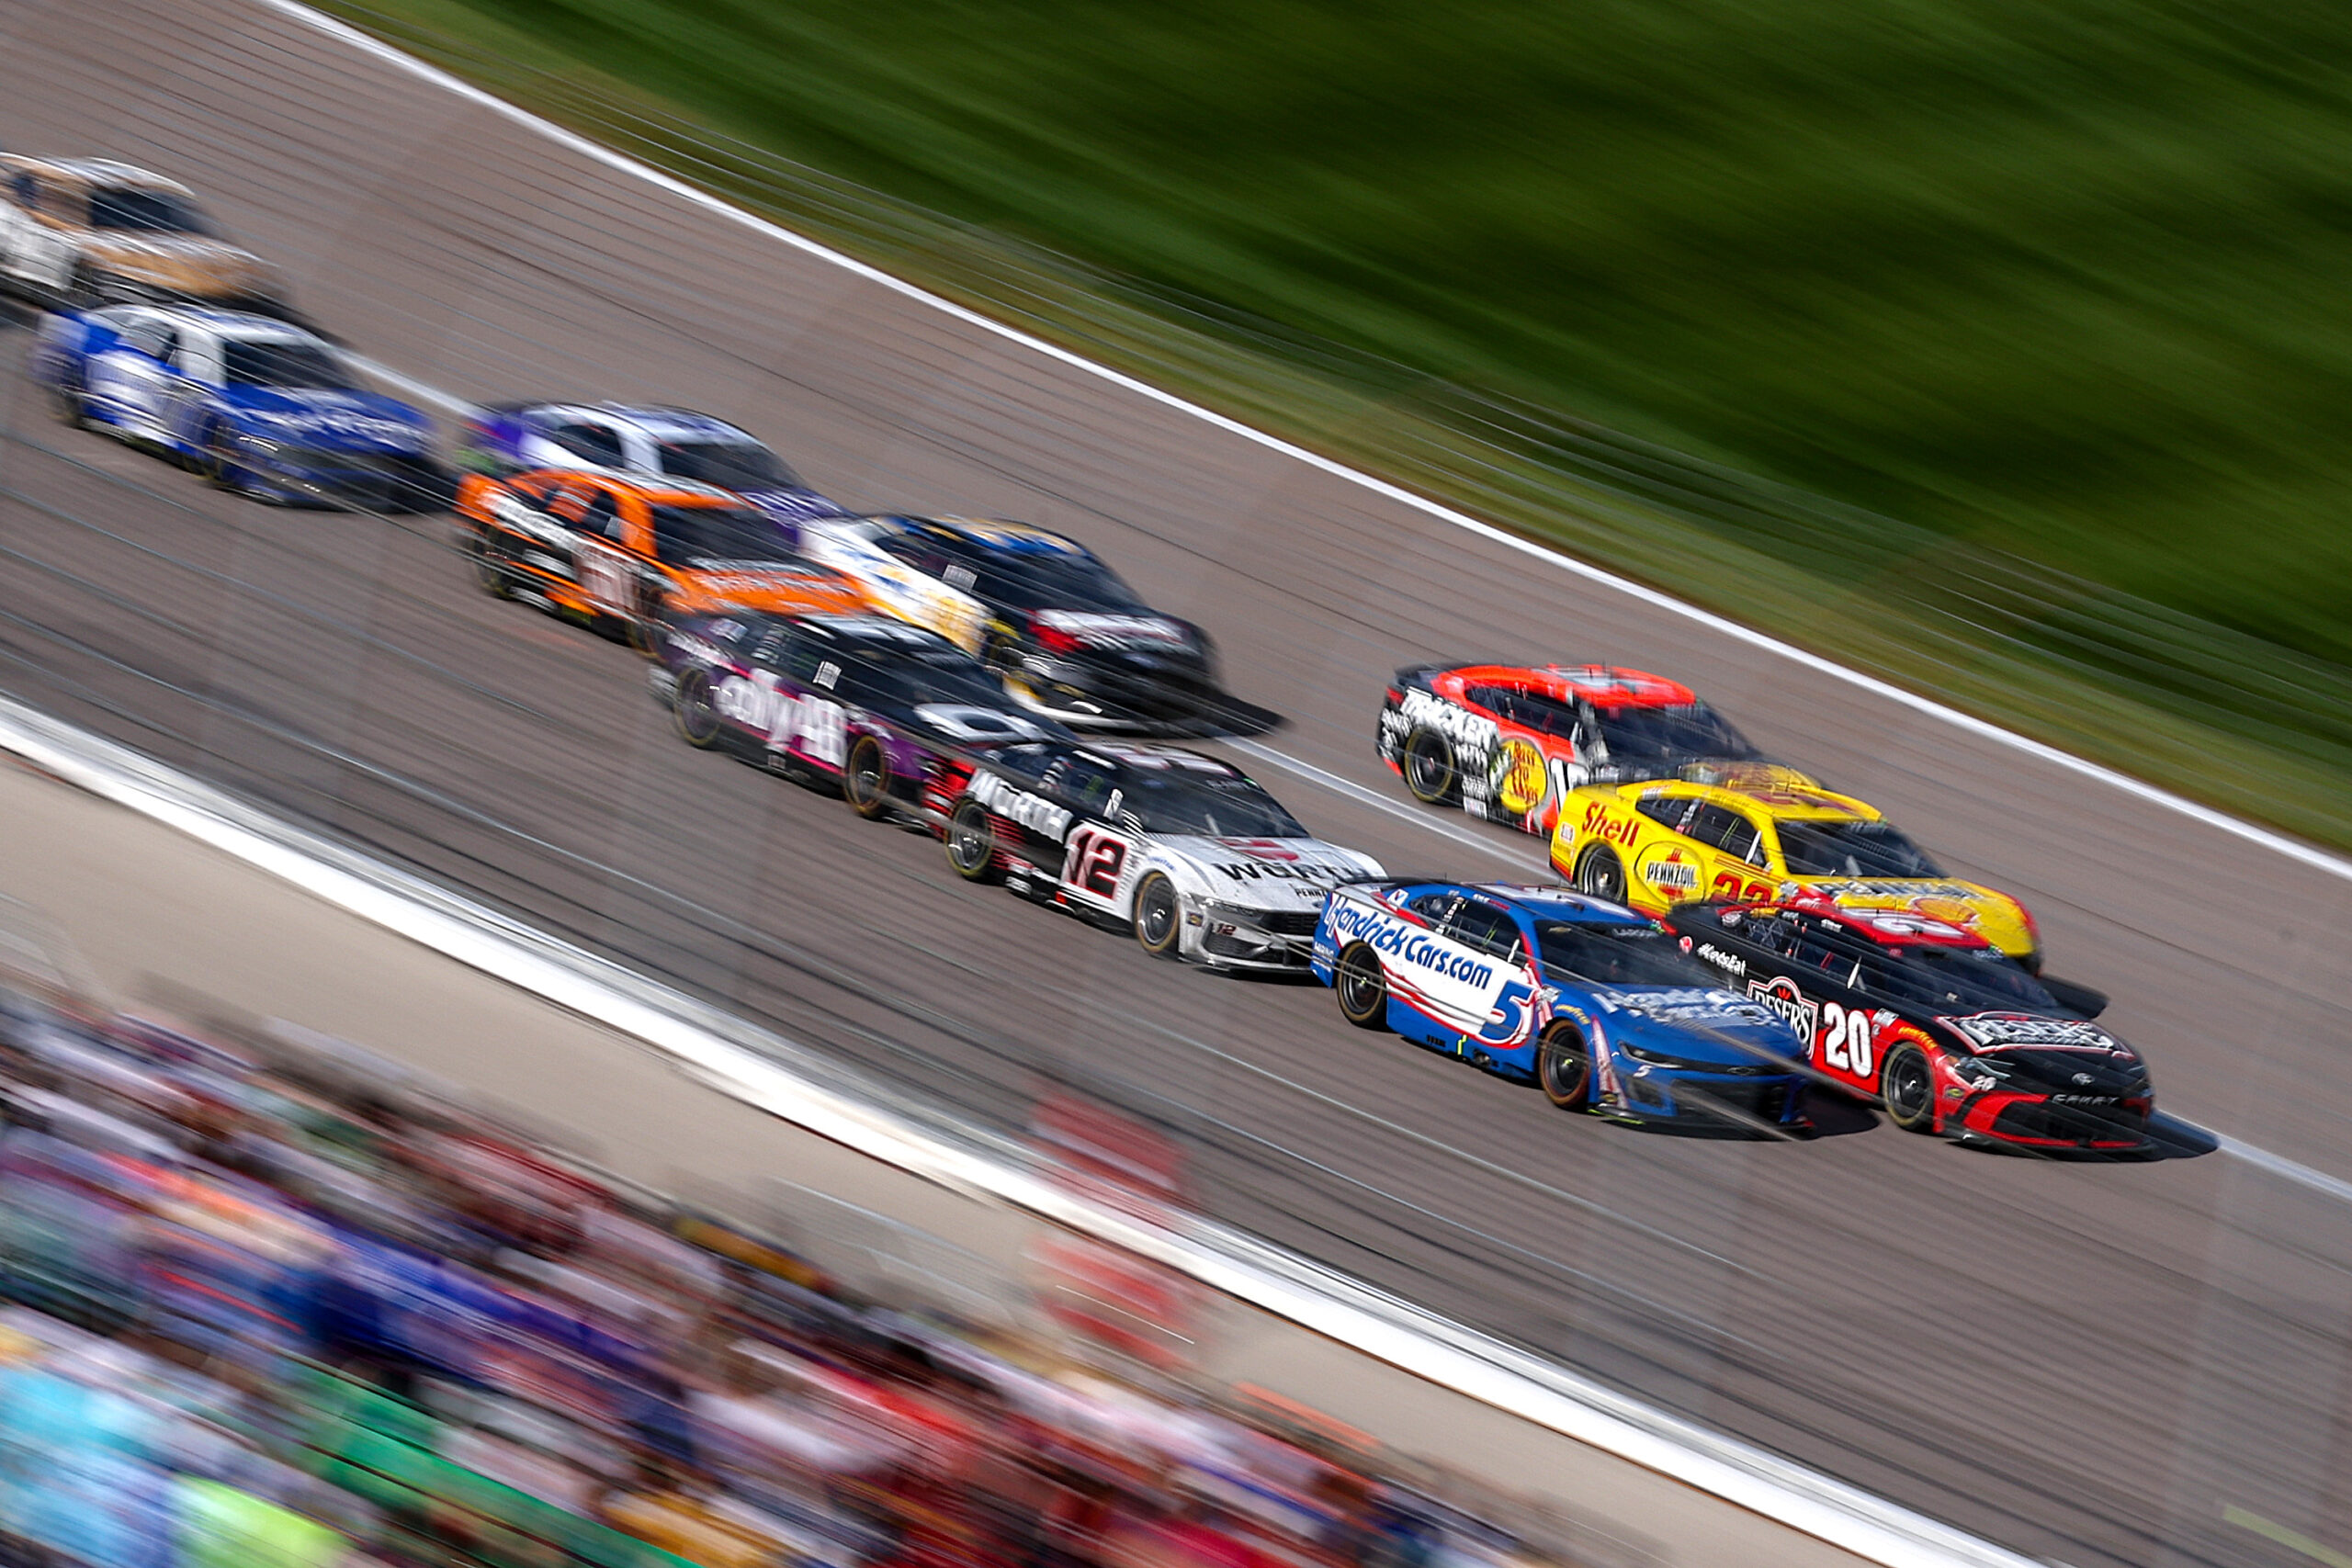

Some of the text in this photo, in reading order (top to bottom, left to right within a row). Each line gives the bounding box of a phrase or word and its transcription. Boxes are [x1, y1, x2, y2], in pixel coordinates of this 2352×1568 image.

[1582, 801, 1641, 847] Shell
[1062, 828, 1126, 900] 12
[1646, 862, 1698, 888] PENNZOIL
[1295, 887, 1328, 899] PENNZ
[1216, 923, 1238, 936] 12
[1697, 942, 1747, 977] #LetsEat
[1478, 979, 1536, 1041] 5
[1823, 1000, 1873, 1078] 20
[1633, 1064, 1653, 1078] 5
